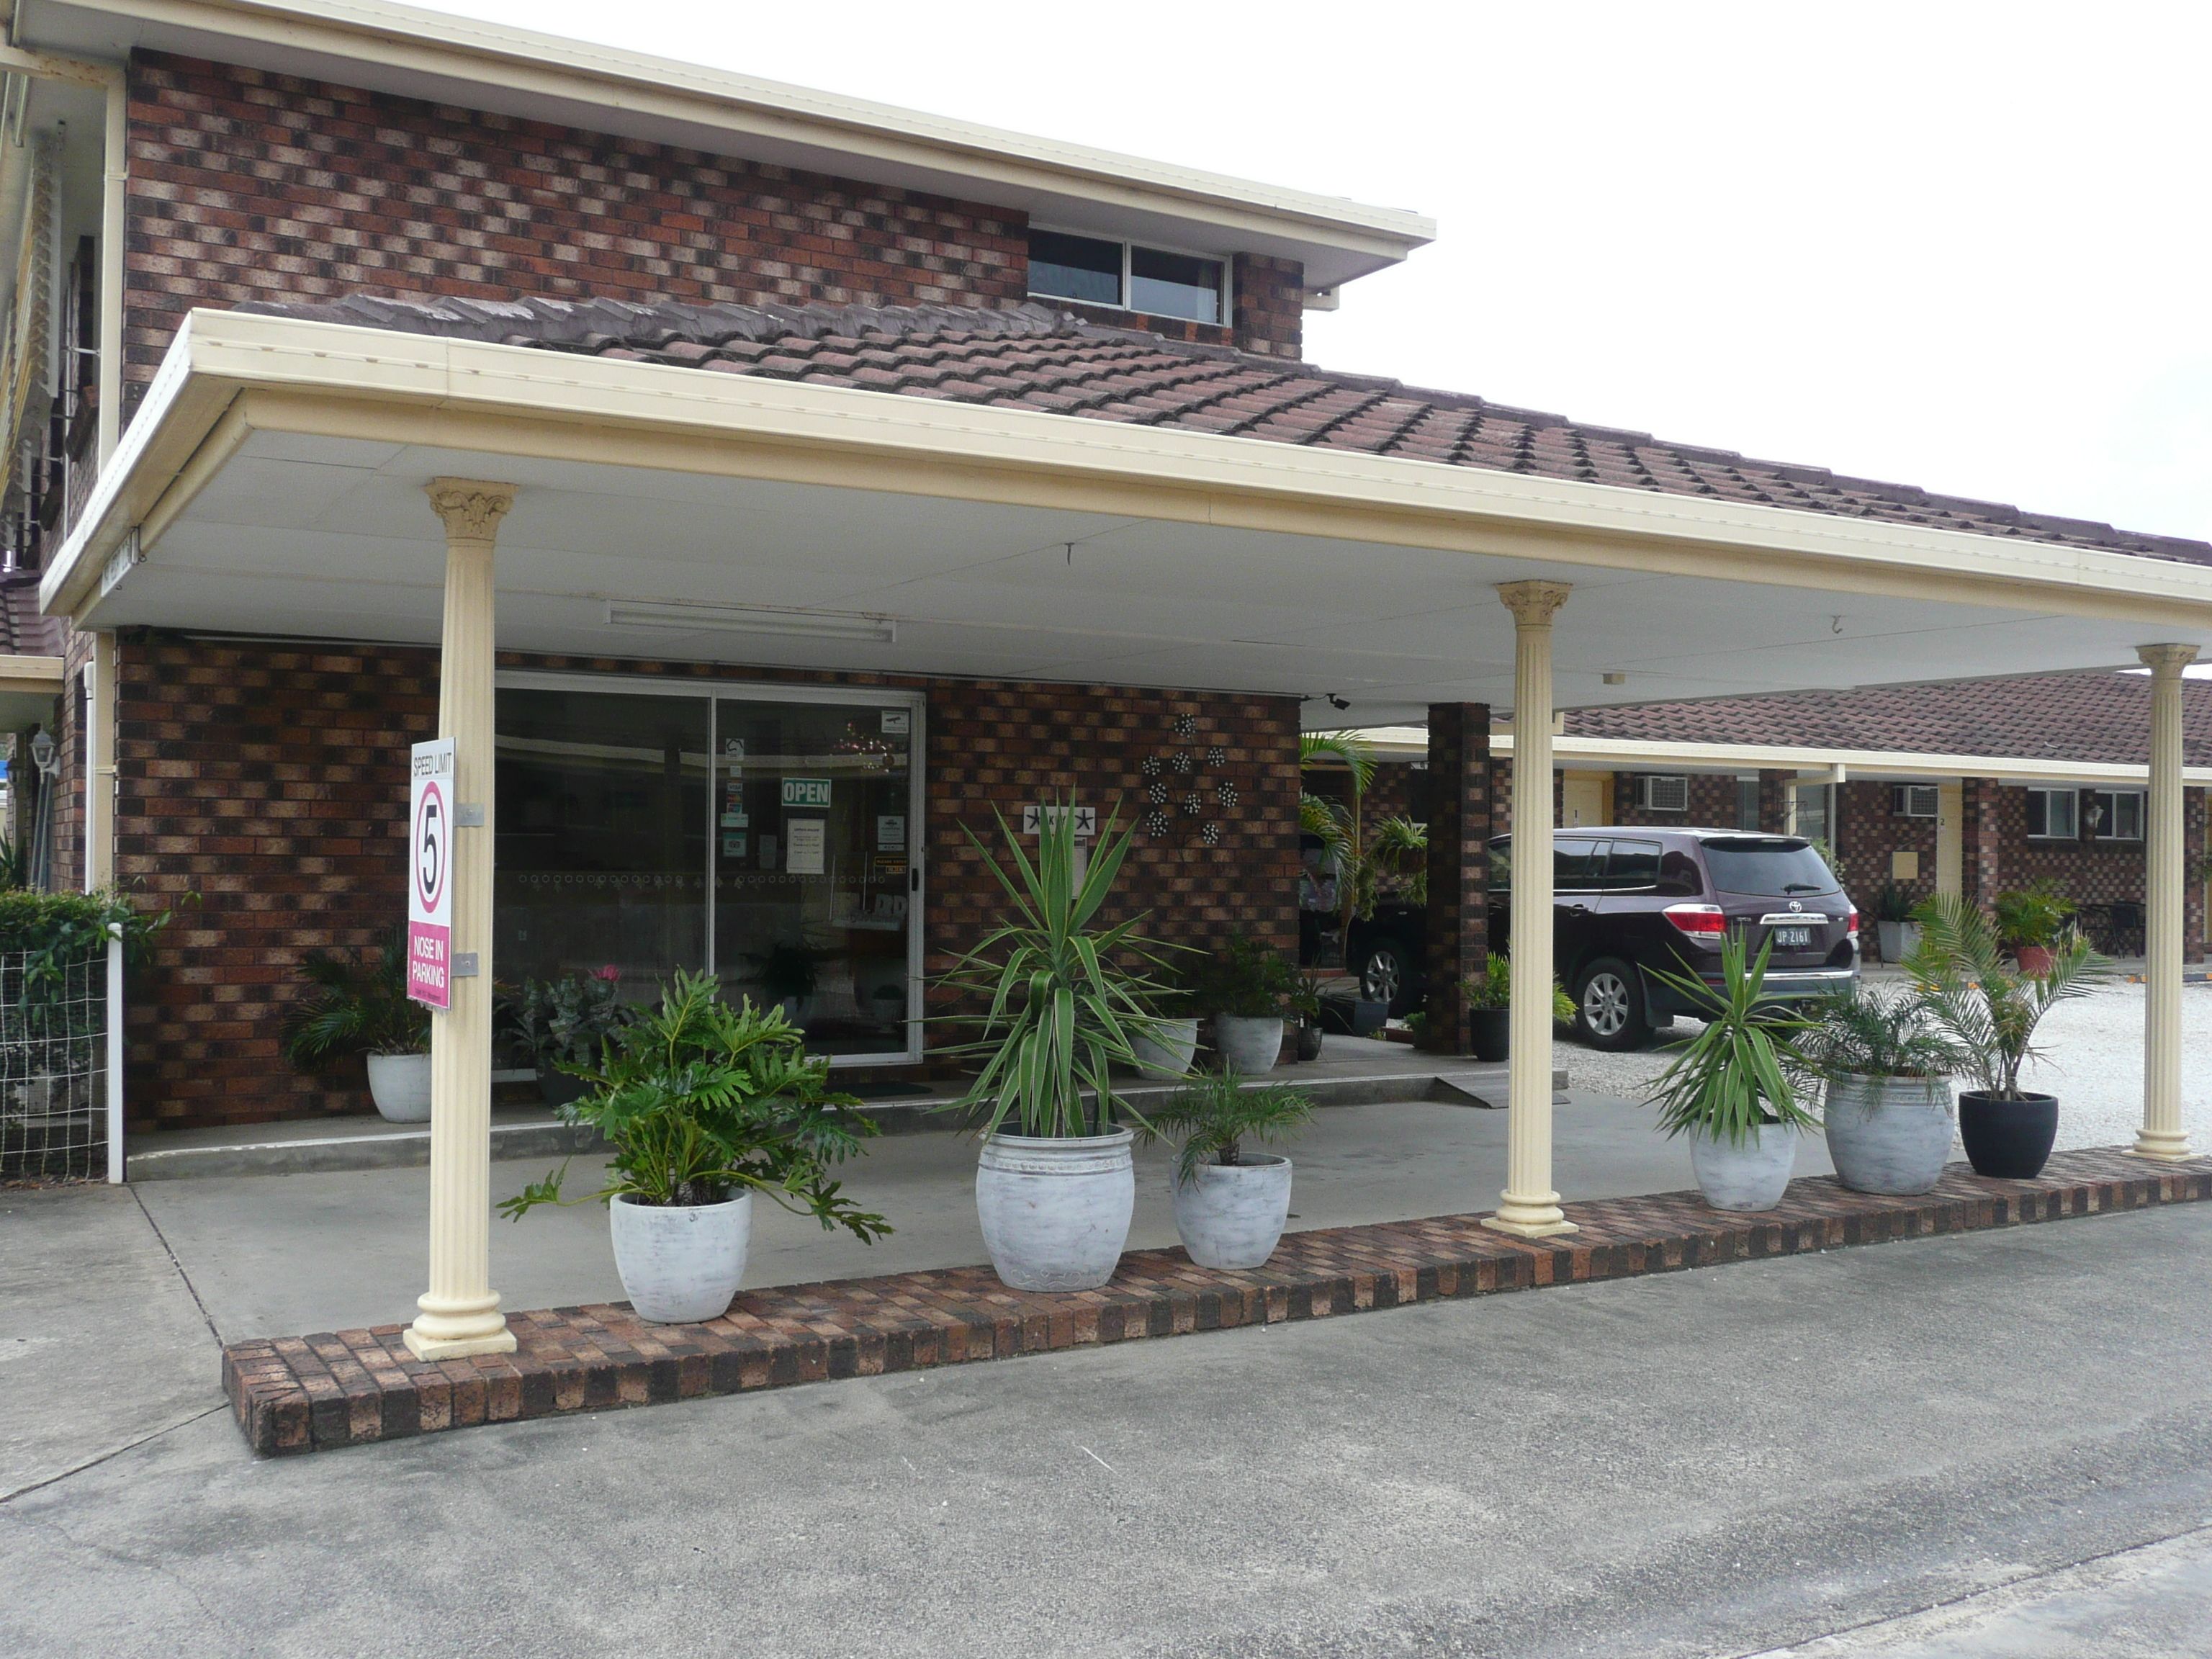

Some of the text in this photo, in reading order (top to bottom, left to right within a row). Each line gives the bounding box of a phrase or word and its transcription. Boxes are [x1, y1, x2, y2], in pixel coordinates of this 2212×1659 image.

[414, 752, 452, 777] SPEED LIMIT
[783, 782, 829, 803] OPEN
[423, 804, 438, 895] 5
[414, 935, 444, 962] NOSE IN
[413, 961, 444, 989] PARKING
